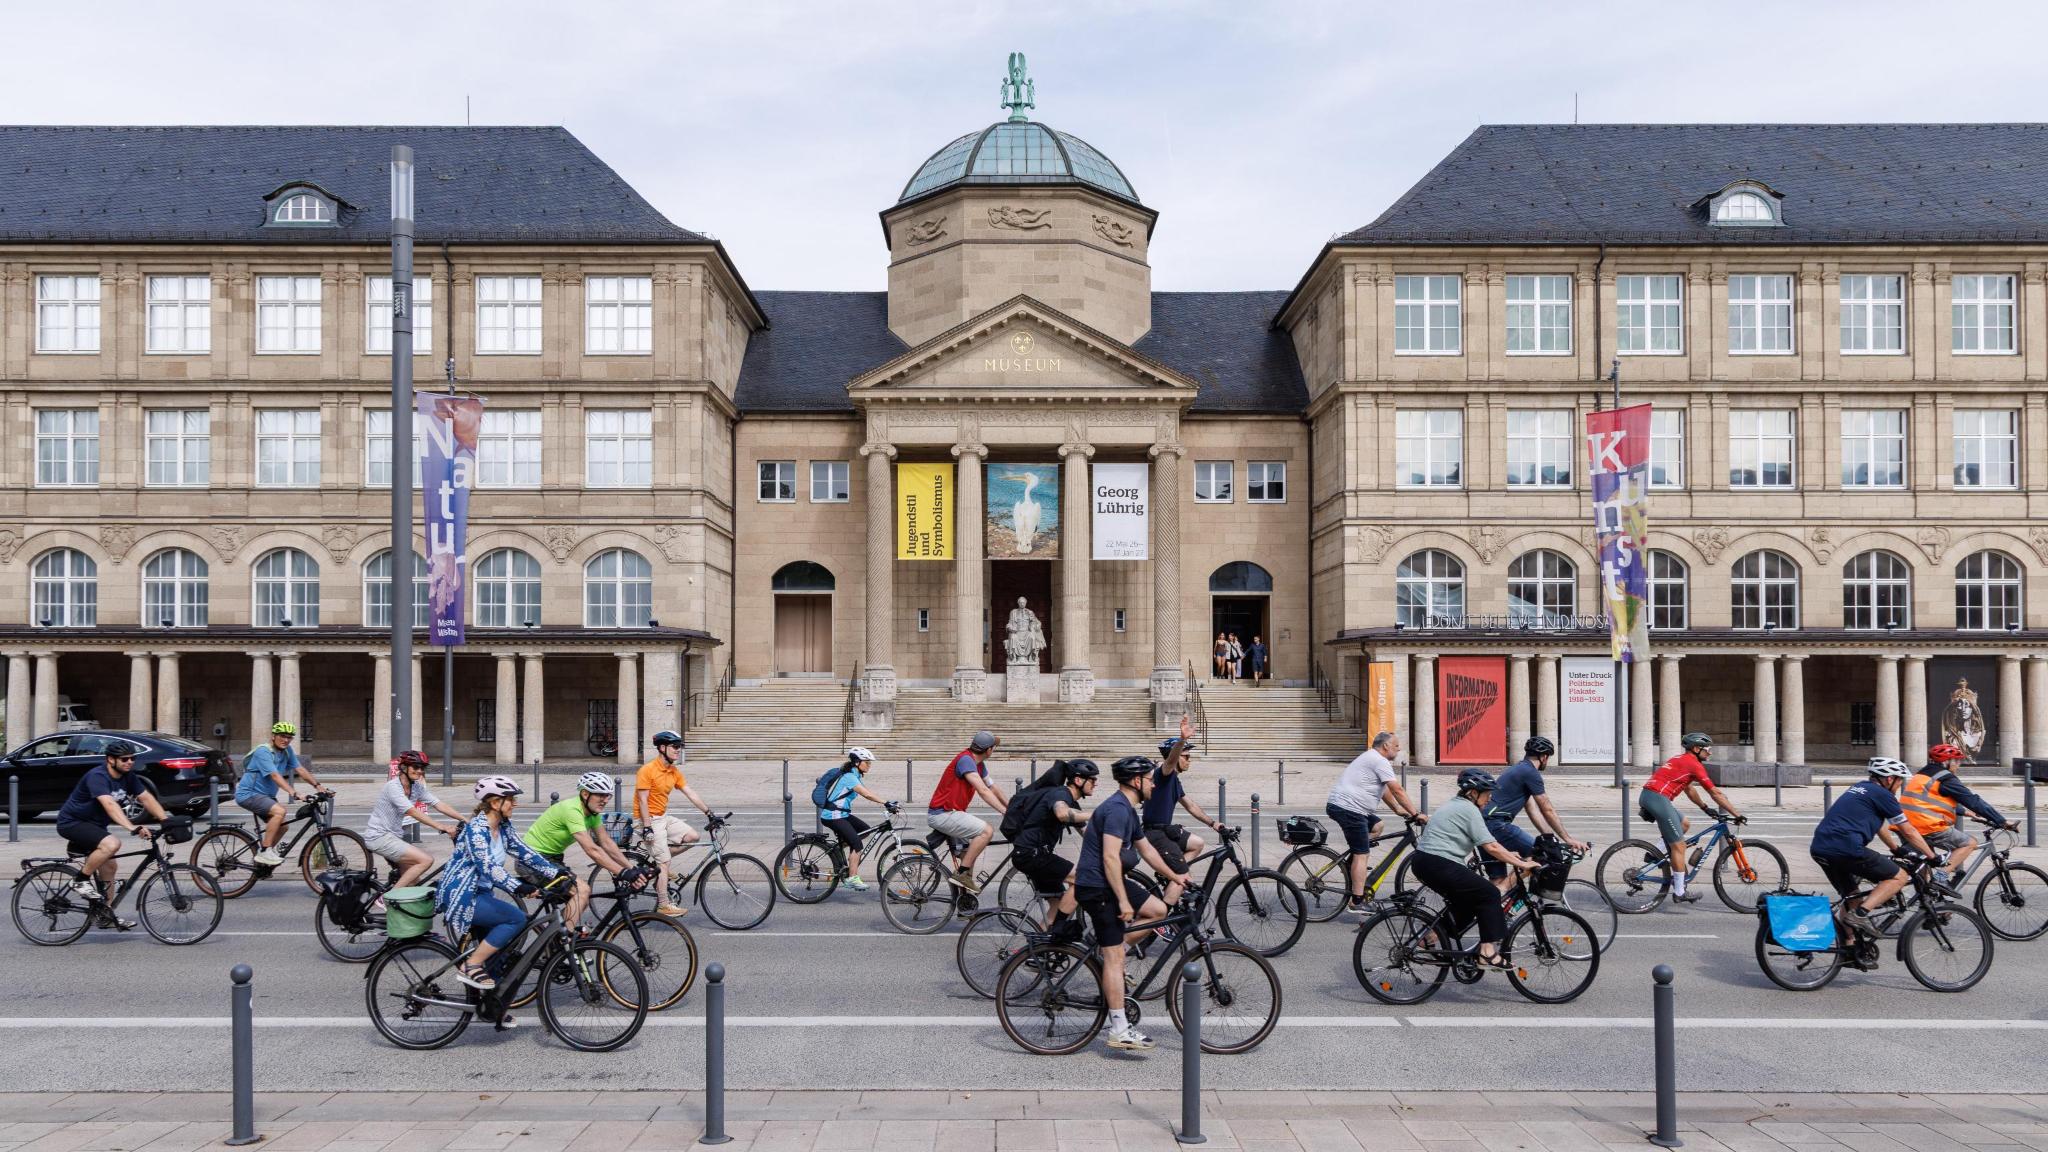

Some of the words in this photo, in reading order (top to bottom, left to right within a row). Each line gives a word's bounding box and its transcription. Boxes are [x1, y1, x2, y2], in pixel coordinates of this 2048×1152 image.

[985, 359, 1061, 372] MUSEUM
[1097, 485, 1139, 500] Georg
[933, 474, 944, 556] Symbolismus
[1097, 501, 1144, 516] Lührig
[1588, 430, 1648, 601] Kunst
[906, 494, 918, 556] Jugendstil
[919, 532, 930, 556] und
[1480, 614, 1533, 629] BELIEVE
[1542, 614, 1556, 629] IN
[1561, 614, 1609, 629] DINOSA
[1446, 697, 1499, 728] MANIPULATION
